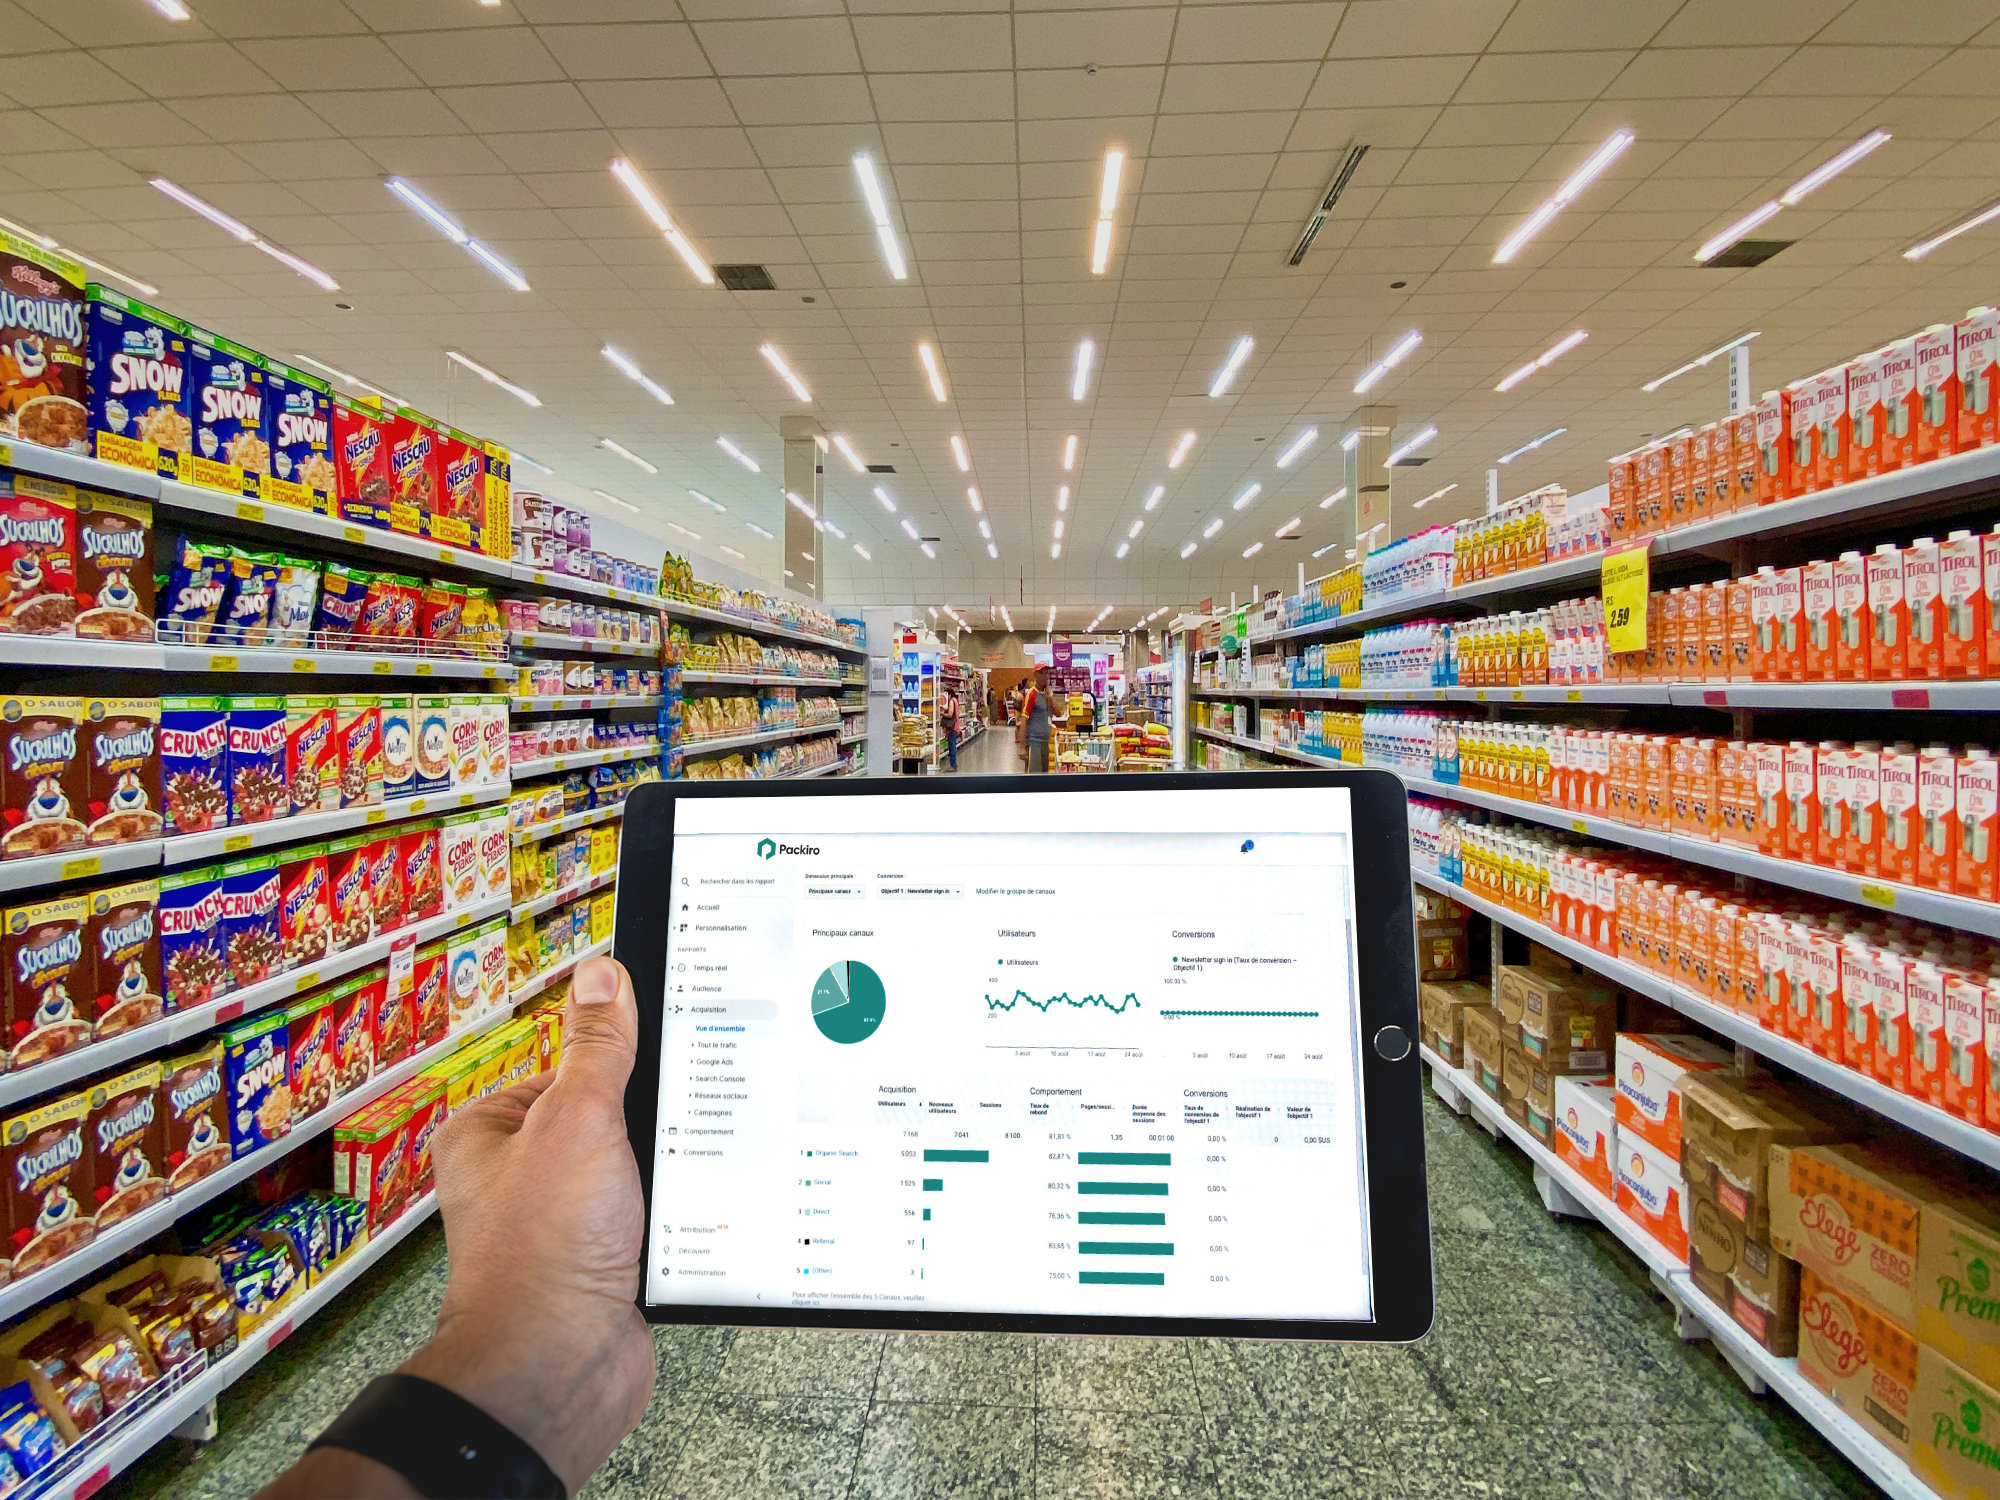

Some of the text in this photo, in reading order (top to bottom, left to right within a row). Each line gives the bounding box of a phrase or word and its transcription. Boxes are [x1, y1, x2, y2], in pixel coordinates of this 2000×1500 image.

[1958, 326, 1997, 351] TIROL
[1881, 358, 1915, 380] TIROL
[1917, 343, 1953, 366] TIROL
[110, 352, 183, 394] SNOW
[1850, 370, 1879, 392] TIROL
[203, 385, 261, 423] SNOW
[99, 434, 143, 453] EMBALAGEM
[277, 412, 328, 448] SNOW
[100, 446, 157, 471] ECONÔMICA
[345, 430, 380, 464] NESCAU
[391, 437, 431, 474] NESCAU
[195, 470, 242, 491] ECONÔMICA
[445, 456, 480, 492] NESCAU
[272, 490, 312, 509] ECONÔMICA
[0, 514, 64, 546] SUCRILHOS
[82, 525, 145, 559] SUCRILHOS
[1868, 567, 1902, 583] TIROL
[1905, 561, 1938, 578] TIROL
[1941, 555, 1979, 573] TIROL
[1804, 577, 1833, 592] TIROL
[1835, 572, 1863, 589] TIROL
[175, 586, 225, 613] SNOW
[363, 597, 394, 624] NESCAU
[429, 603, 461, 633] NESCAU
[161, 722, 226, 756] CRUNCH
[230, 720, 286, 755] CRUNCH
[297, 719, 332, 759] NESCAU
[347, 716, 378, 751] NESCAU
[452, 719, 478, 743] CORN
[483, 719, 505, 742] CORN
[10, 729, 77, 771] SUCRILHOS
[96, 727, 154, 771] SUCRILHOS
[1818, 762, 1846, 778] TIROL
[1845, 764, 1878, 782] TIROL
[1882, 768, 1915, 785] TIROL
[1921, 770, 1954, 789] TIROL
[1958, 773, 1997, 792] TIROL
[448, 837, 474, 866] CORN
[481, 829, 505, 858] CORN
[780, 844, 820, 855] Packiro
[371, 846, 397, 887] NESCAU
[405, 838, 436, 880] NESCAU
[285, 865, 325, 922] NESCAU
[336, 857, 369, 908] NESCAU
[160, 888, 223, 933] CRUNCH
[223, 880, 280, 917] CRUNCH
[101, 909, 154, 960] SUCRILHOS
[813, 929, 847, 937] Principaux
[17, 927, 82, 984] SUCRILHOS
[482, 941, 505, 973] CORN
[417, 960, 446, 1007] NESCAU
[1907, 983, 1943, 1008] TIROL
[337, 998, 370, 1054] NESCAU
[292, 1015, 331, 1079] NESCAU
[696, 1058, 733, 1067] Google Ads
[170, 1065, 221, 1120] SUCRILHOS
[236, 1050, 287, 1110] SNOW
[879, 1086, 916, 1094] Acquisition
[1030, 1087, 1082, 1096] Comportement
[1184, 1089, 1228, 1097] Conversions
[1618, 1078, 1659, 1114] Piracanjuba
[98, 1092, 155, 1155] SUCRILHOS
[17, 1124, 82, 1193] SUCRILHOS
[792, 1299, 809, 1307] cliquer
